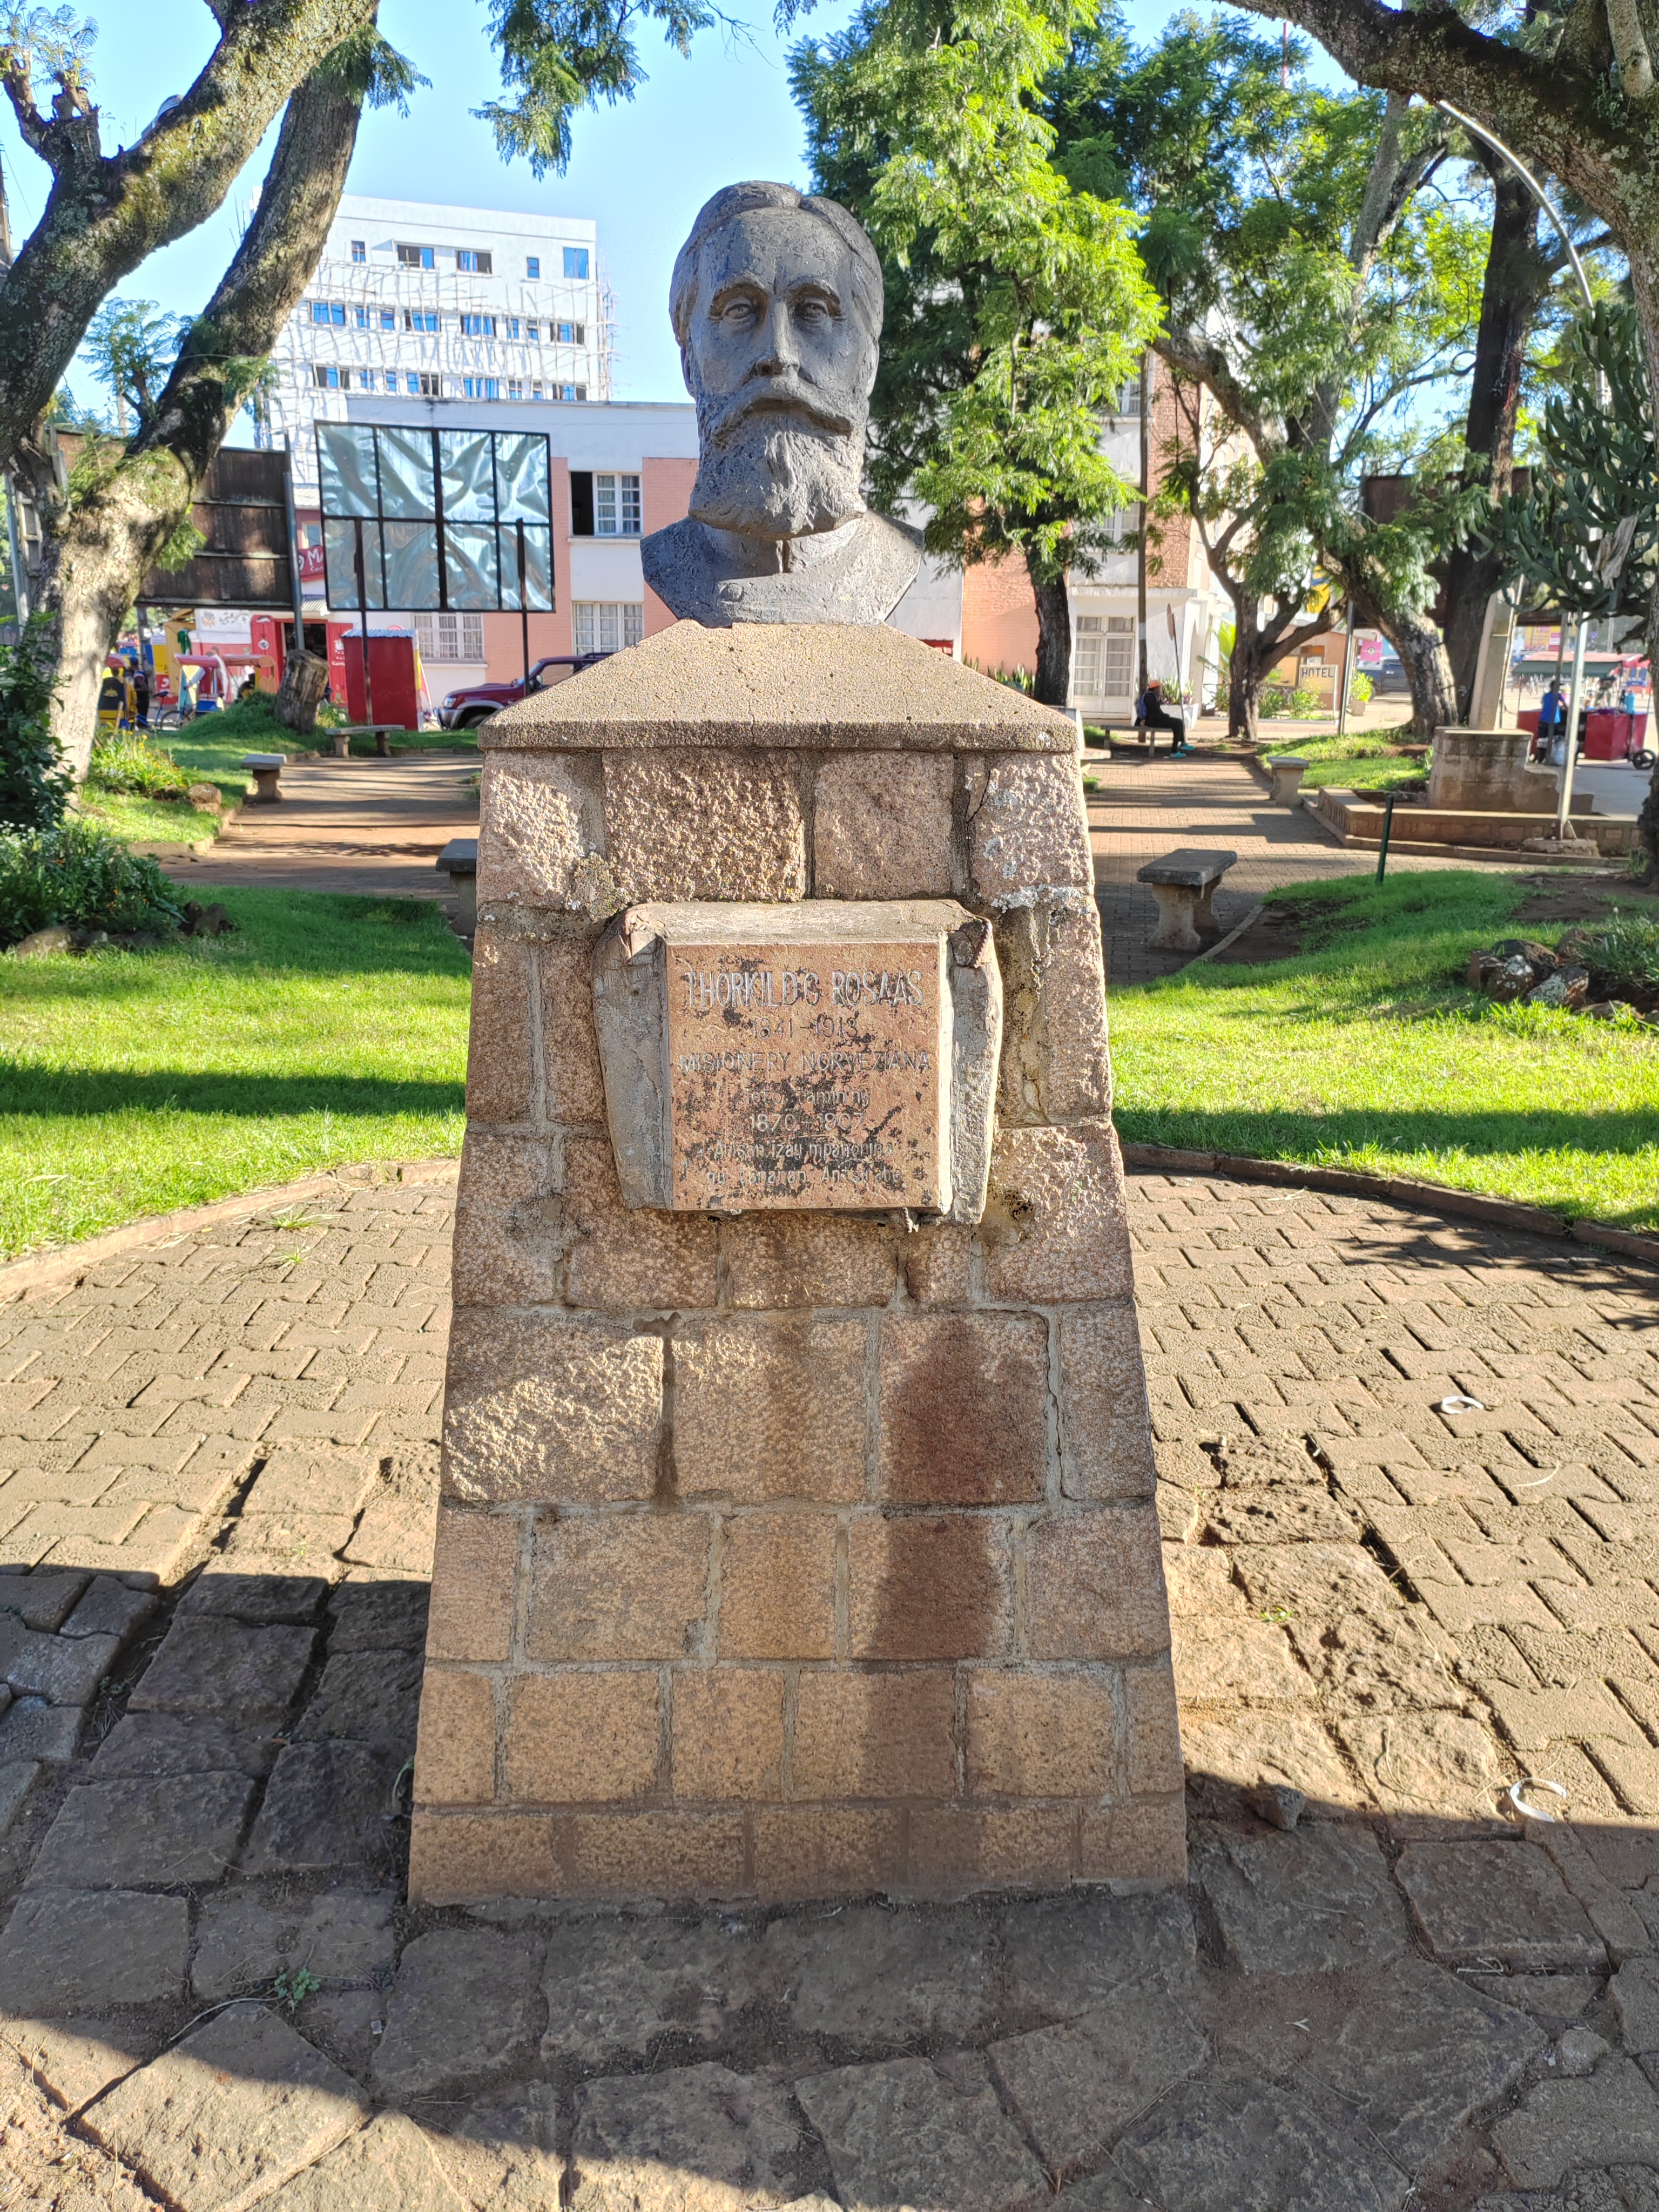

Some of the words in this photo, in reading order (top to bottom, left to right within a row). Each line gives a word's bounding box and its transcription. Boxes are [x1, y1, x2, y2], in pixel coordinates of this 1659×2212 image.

[1301, 667, 1334, 678] HOTEL
[684, 971, 798, 1008] THORKILD
[832, 969, 923, 1007] ROSAAS
[678, 1051, 792, 1073] MISIONERY
[800, 1050, 932, 1071] NORVEZIANA
